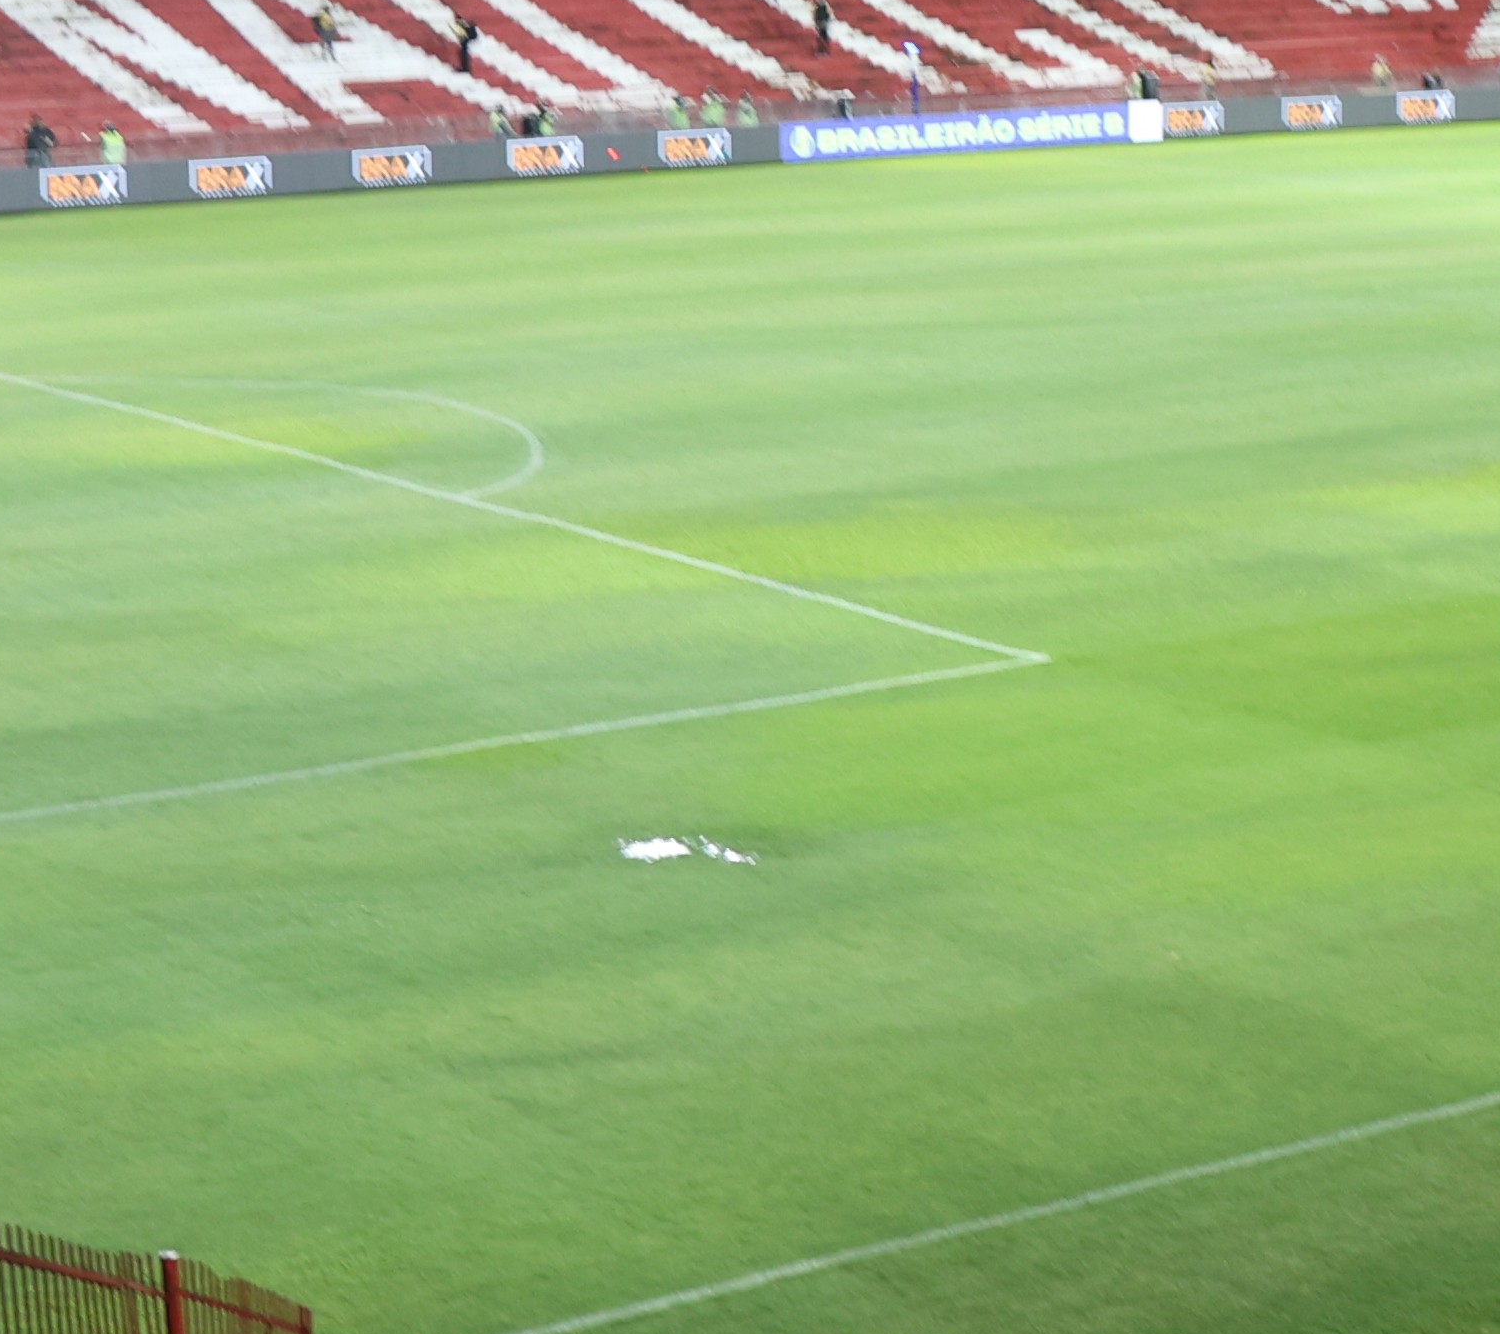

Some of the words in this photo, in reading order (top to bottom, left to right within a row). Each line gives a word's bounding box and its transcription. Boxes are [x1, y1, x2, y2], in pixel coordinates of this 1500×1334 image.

[817, 114, 1017, 153] BRASILEIRÃO
[1017, 110, 1101, 143] SÉRIE
[1102, 112, 1126, 137] B
[361, 151, 426, 179] BRAX
[514, 142, 577, 168] BRAX
[48, 169, 119, 198] BRAX
[197, 161, 265, 189] BRAX
